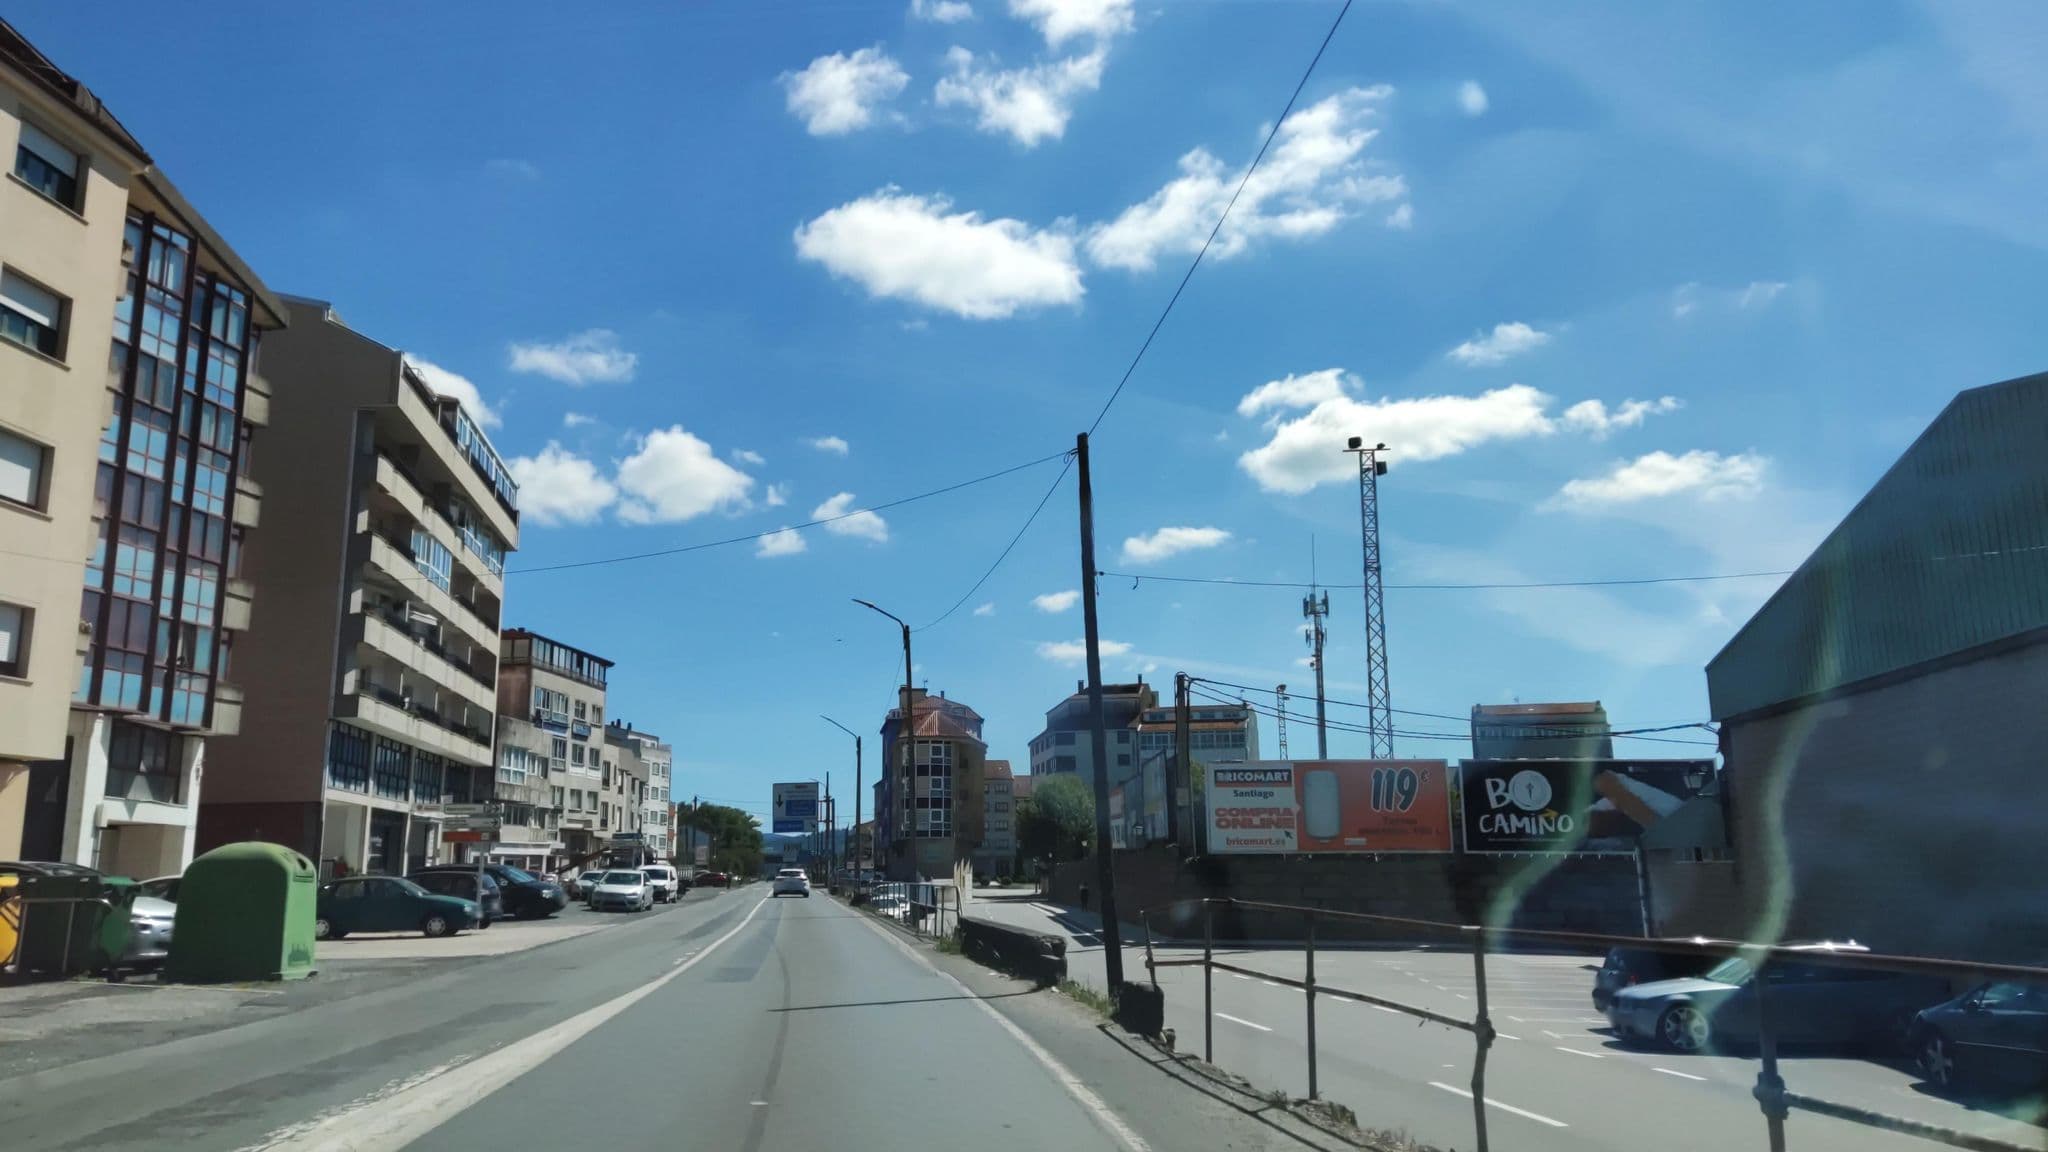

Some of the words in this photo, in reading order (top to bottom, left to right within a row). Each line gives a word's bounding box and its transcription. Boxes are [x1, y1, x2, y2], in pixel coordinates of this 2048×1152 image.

[1216, 771, 1290, 783] BRICOMART
[1233, 789, 1275, 800] Santiago
[1215, 807, 1295, 817] COMPRA
[1215, 818, 1296, 829] ONLINE
